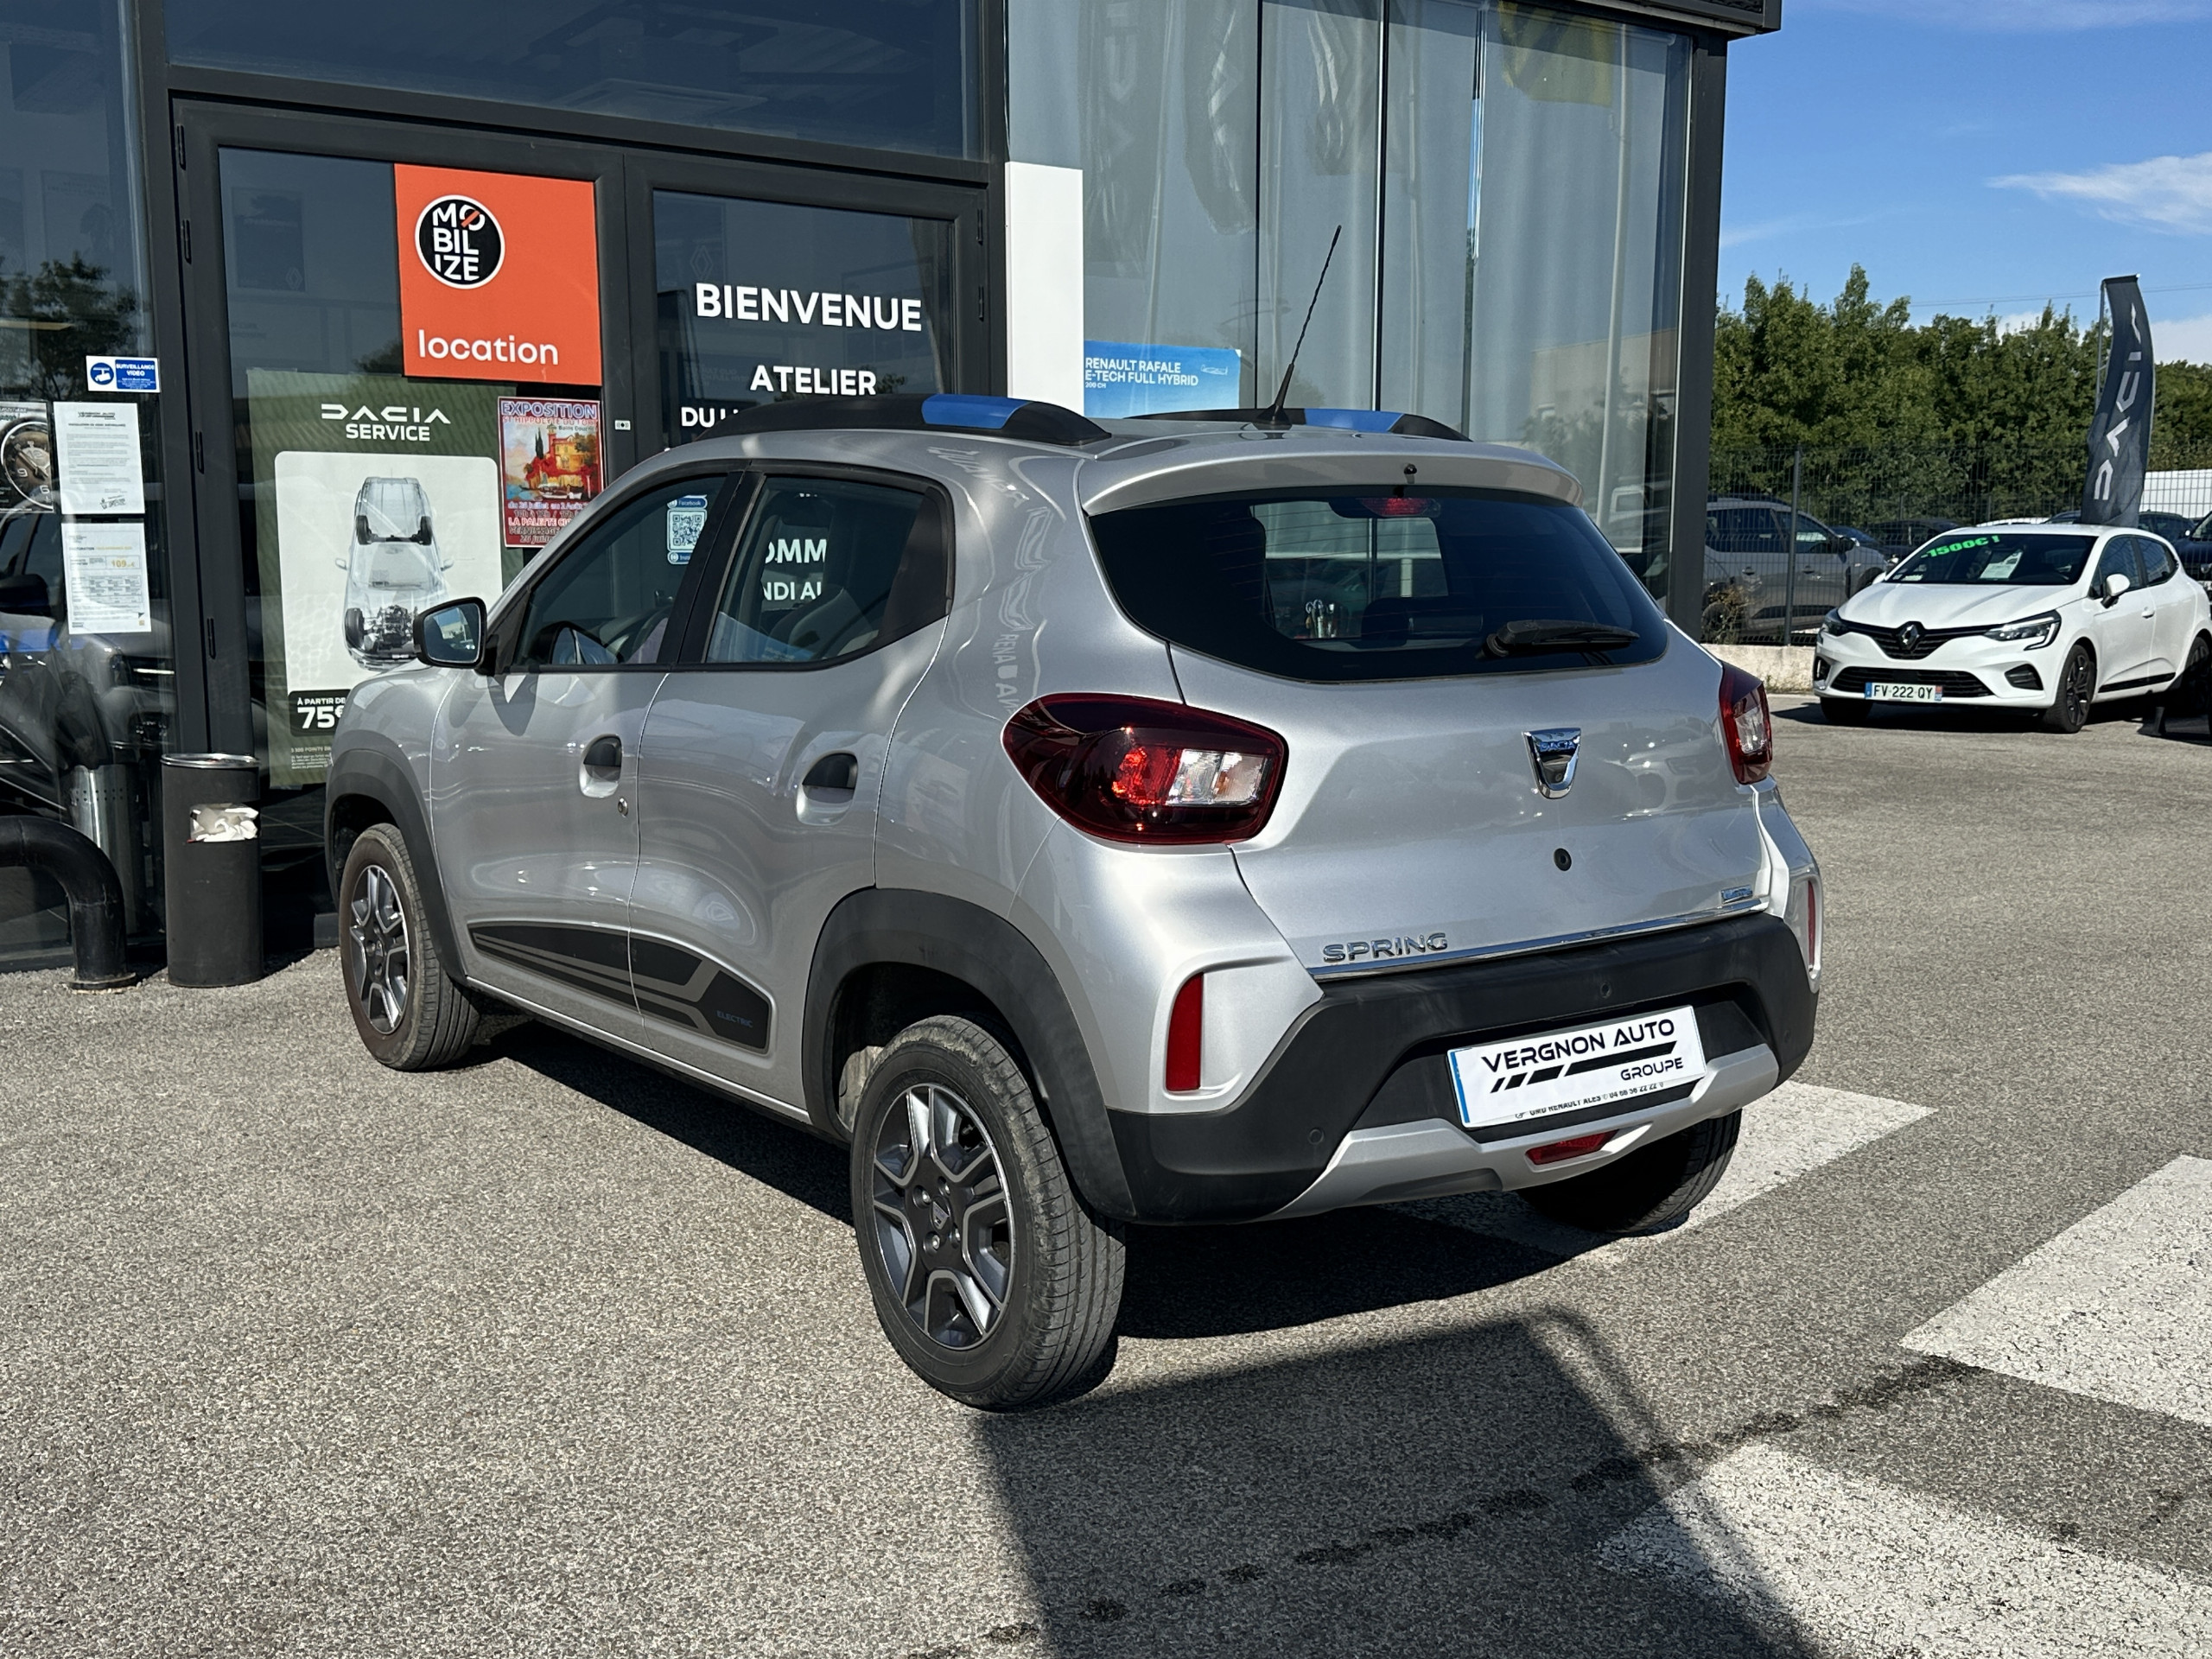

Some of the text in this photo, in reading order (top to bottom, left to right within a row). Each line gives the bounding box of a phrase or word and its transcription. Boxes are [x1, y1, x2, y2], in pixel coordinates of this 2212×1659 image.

[696, 283, 922, 332] BIENVENUE
[418, 329, 559, 365] location
[1085, 357, 1181, 373] RENAULT RAFALE
[750, 365, 877, 396] ATELIER
[1085, 370, 1199, 386] E-TECH FULL HYBRID
[321, 404, 451, 424] DACIA
[501, 400, 597, 419] EXPOSITION
[681, 407, 715, 428] DU
[346, 423, 430, 442] SERVICE
[304, 697, 334, 706] PARTIR
[1323, 931, 1448, 963] SPRING
[1481, 1019, 1675, 1073] VERGNON AUTO
[1620, 1057, 1684, 1081] GROUPE
